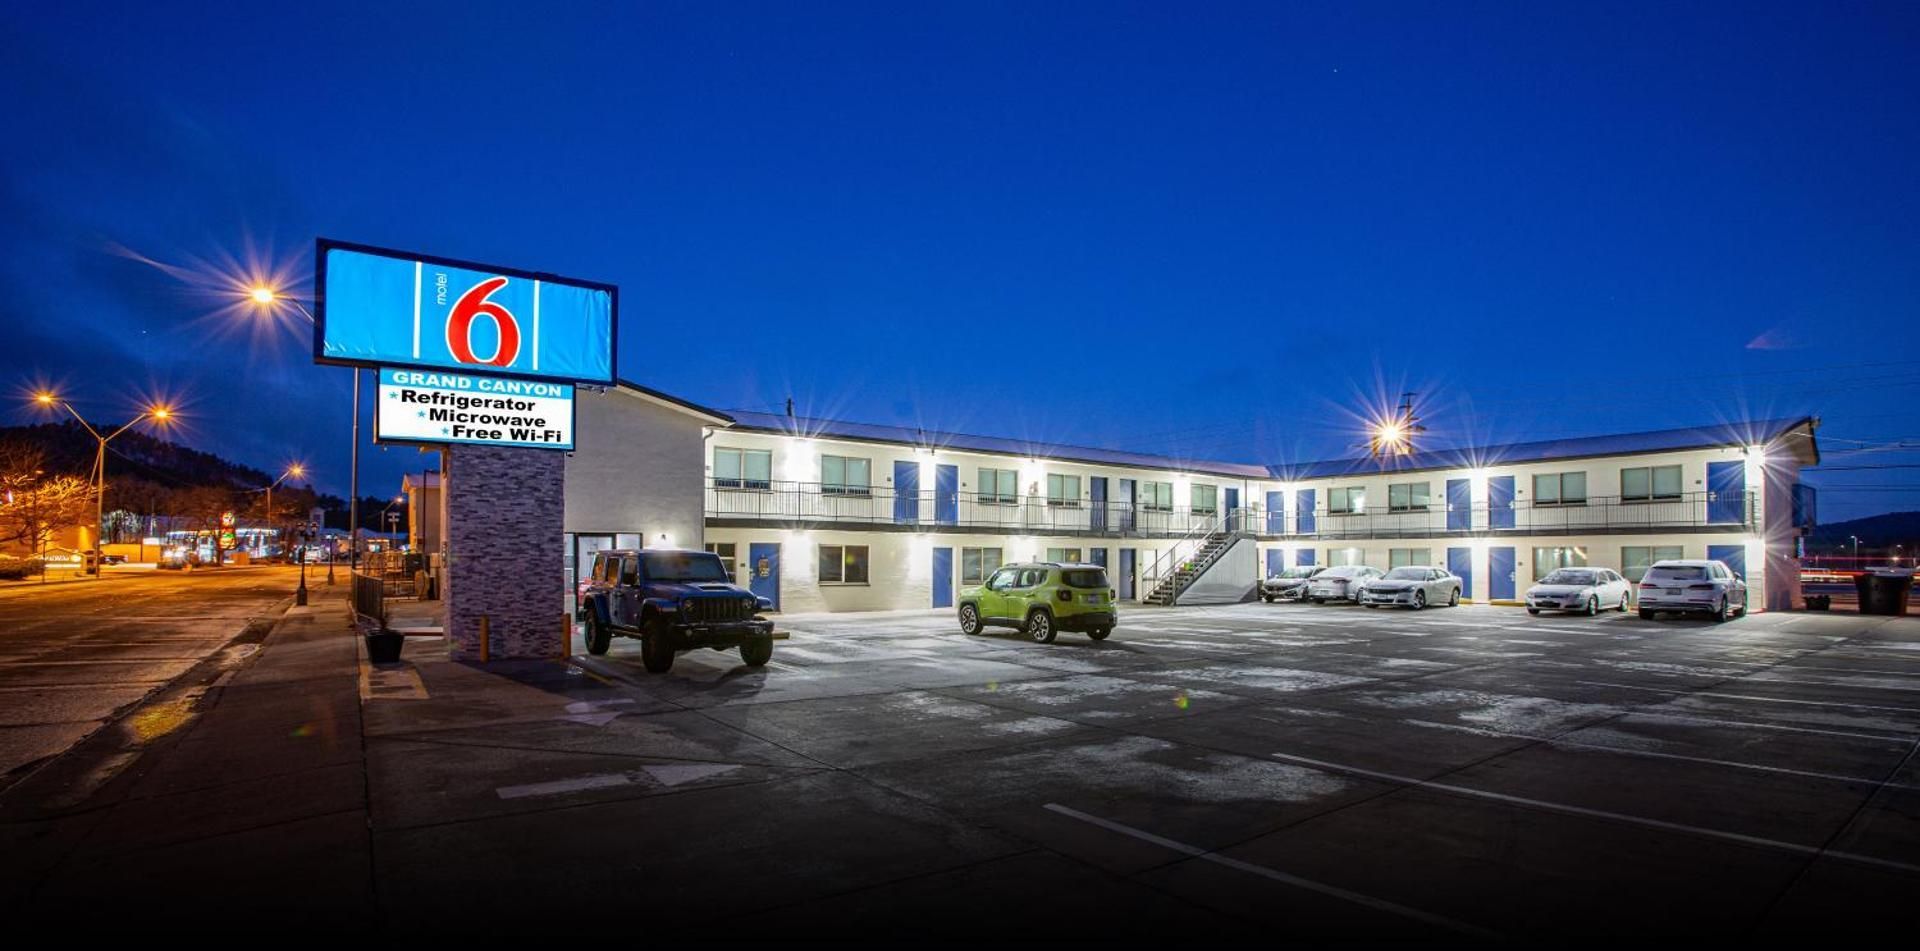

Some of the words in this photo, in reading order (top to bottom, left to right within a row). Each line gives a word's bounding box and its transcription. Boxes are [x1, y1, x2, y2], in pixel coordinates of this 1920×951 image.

[435, 273, 448, 305] motel
[445, 276, 522, 368] 6
[392, 371, 471, 389] GRAND
[478, 379, 562, 397] CANYON
[401, 389, 536, 412] Refrigerator
[429, 408, 546, 428] Microwave
[452, 425, 502, 440] Free
[510, 428, 562, 443] Wi-Fi
